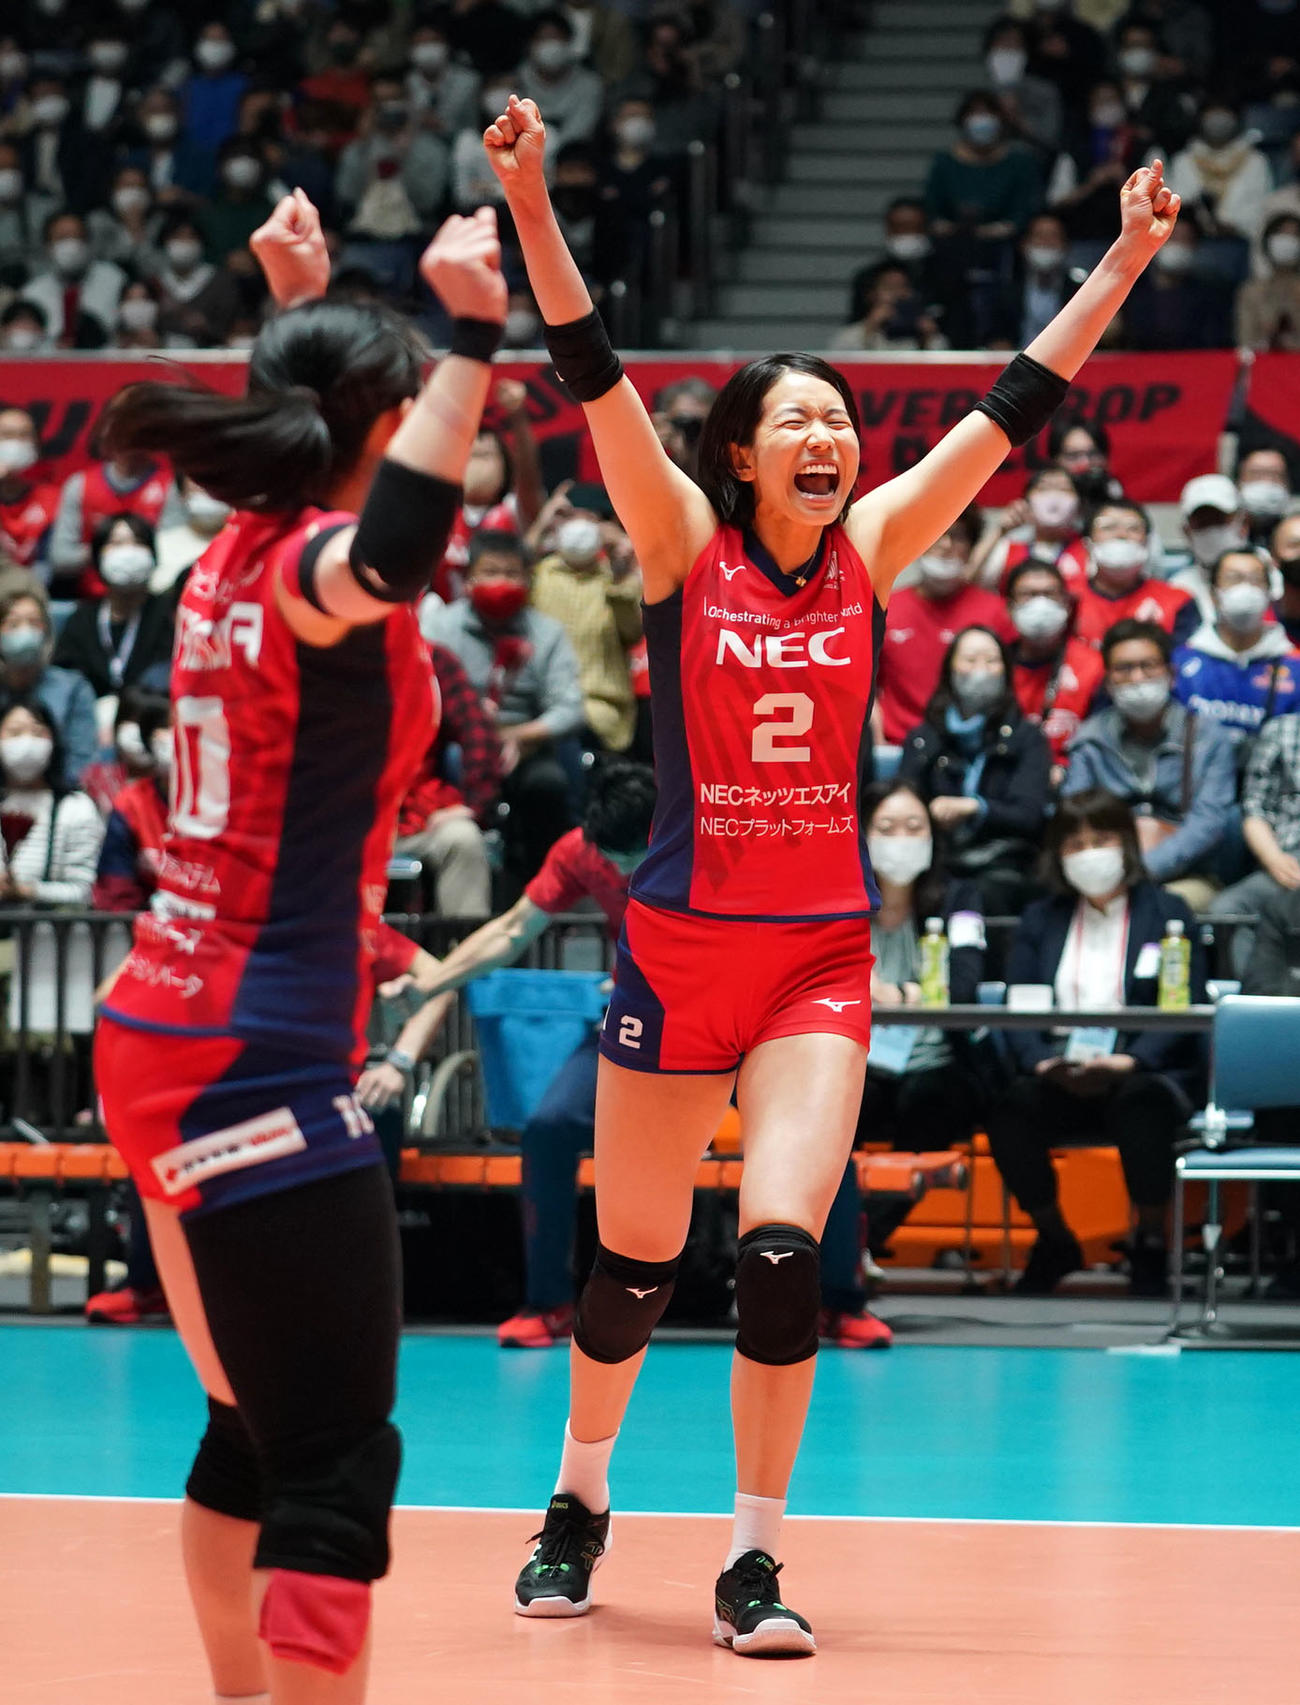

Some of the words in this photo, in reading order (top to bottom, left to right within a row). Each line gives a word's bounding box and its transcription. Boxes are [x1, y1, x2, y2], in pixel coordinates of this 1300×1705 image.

[783, 620, 791, 629] a
[716, 627, 851, 668] NEC
[752, 692, 815, 762] 2
[701, 783, 851, 806] NECネッツエスアイ
[701, 815, 854, 837] NECプラットフォームズ
[619, 1015, 643, 1049] 2
